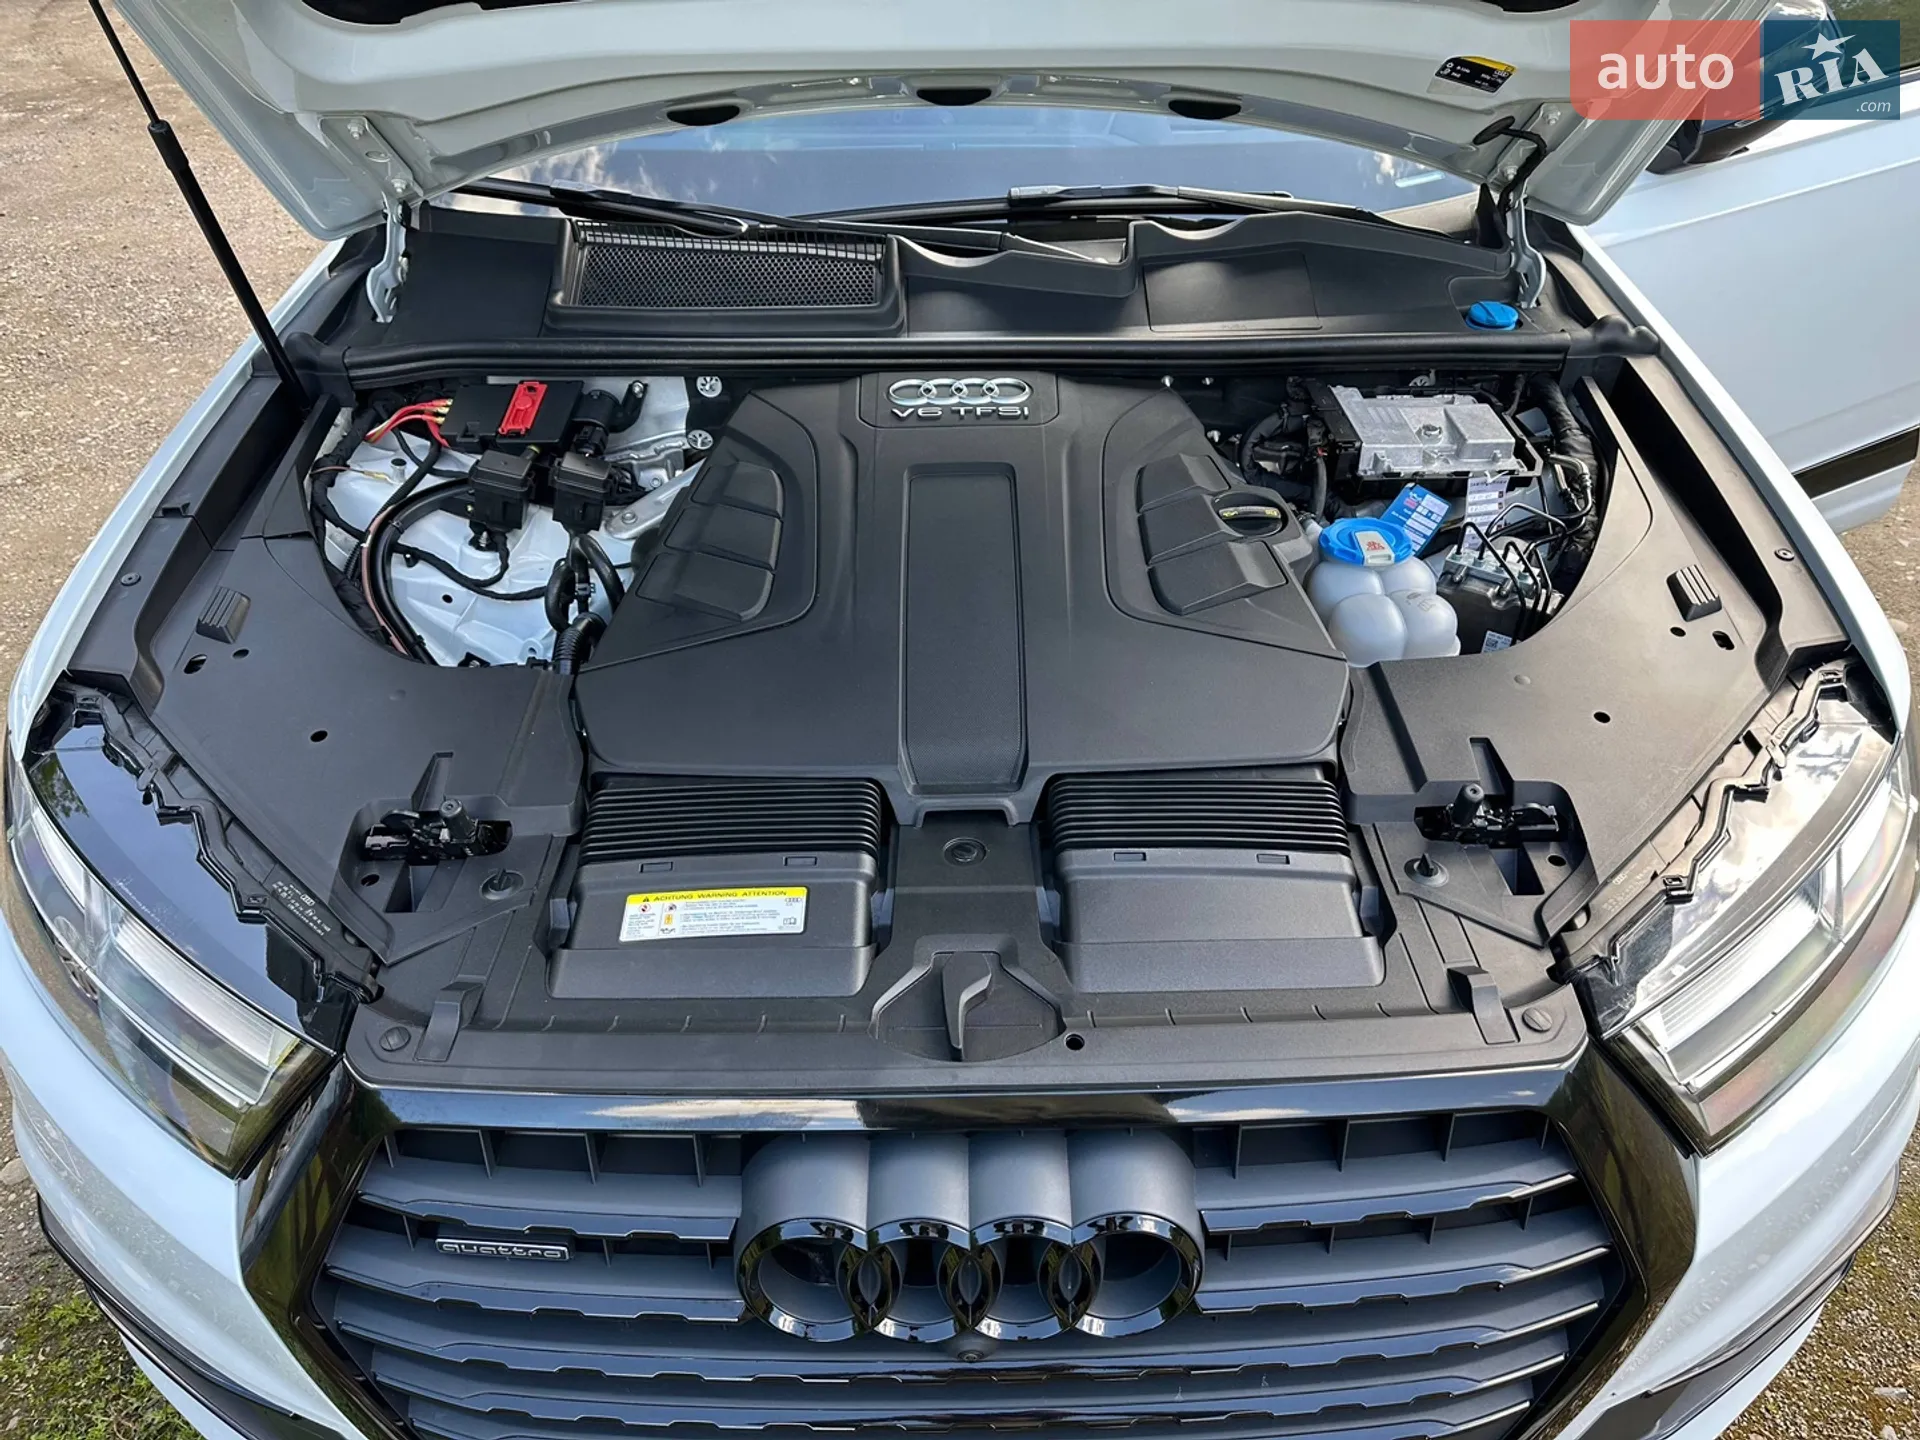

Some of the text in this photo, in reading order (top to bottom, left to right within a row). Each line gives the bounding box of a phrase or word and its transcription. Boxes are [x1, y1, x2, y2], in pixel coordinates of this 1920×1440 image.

[891, 406, 1029, 419] V6 TFSI
[442, 1243, 562, 1258] quattro
